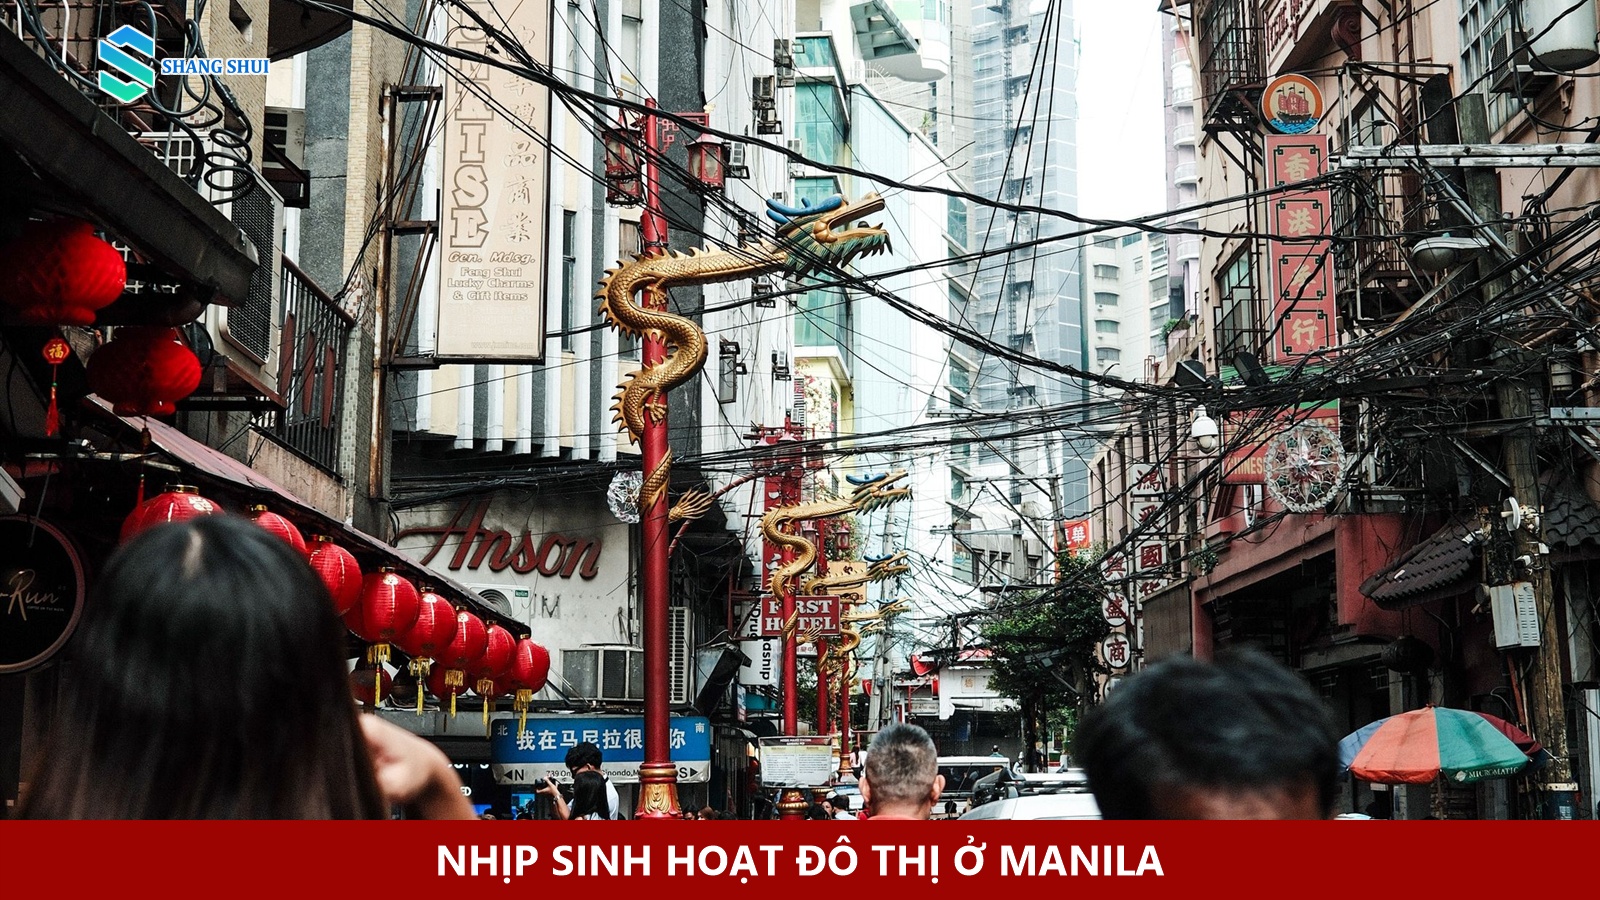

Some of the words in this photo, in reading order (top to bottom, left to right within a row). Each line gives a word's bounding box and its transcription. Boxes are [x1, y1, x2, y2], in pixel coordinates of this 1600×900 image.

[448, 250, 483, 263] Gen.
[489, 251, 536, 265] Mdsg.
[460, 266, 491, 279] Feng
[493, 267, 523, 278] Shui
[447, 278, 484, 290] Lucky
[486, 278, 535, 289] Charms
[452, 290, 464, 301] &
[466, 290, 492, 301] Gift
[493, 291, 529, 301] Items
[1227, 457, 1266, 475] CHINES
[399, 496, 602, 581] Anson
[768, 599, 833, 615] FRST
[764, 616, 836, 632] HTEL
[497, 724, 509, 736] 北
[694, 722, 706, 734] 南
[515, 728, 687, 751] 我在马尼拉很你
[514, 769, 525, 781] N
[678, 766, 689, 779] S
[1468, 766, 1519, 779] MICROMATIC
